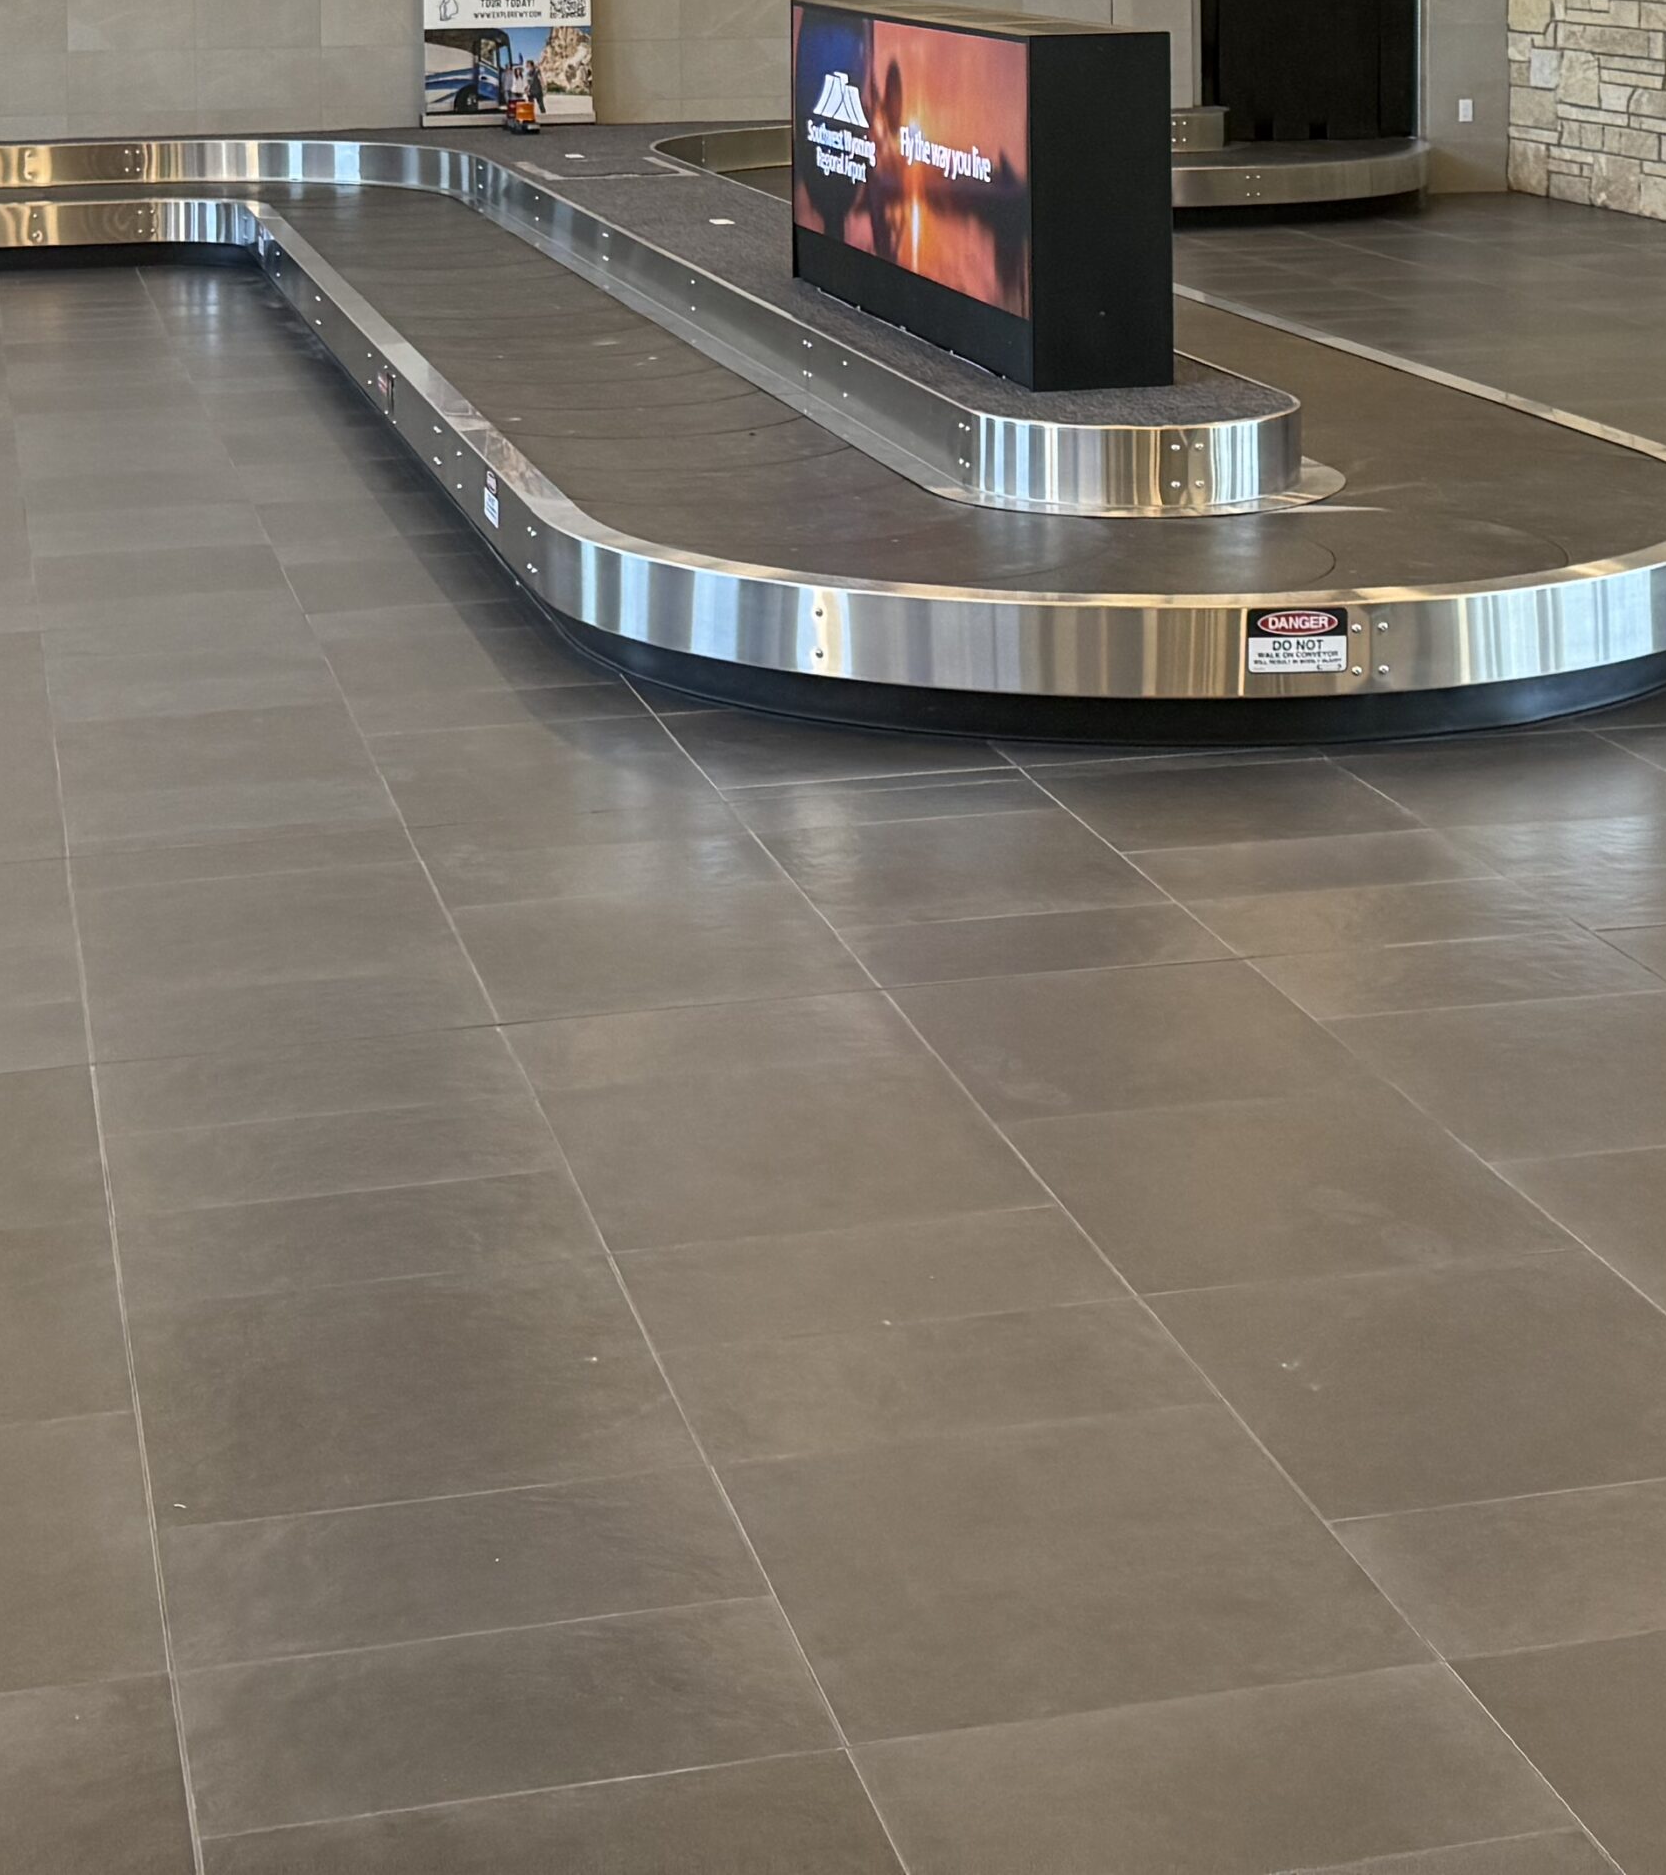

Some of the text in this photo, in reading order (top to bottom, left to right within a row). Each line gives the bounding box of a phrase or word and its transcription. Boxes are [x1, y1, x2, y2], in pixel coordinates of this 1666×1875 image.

[807, 119, 876, 167] Southwest Wyoming
[899, 126, 992, 183] Fly the way you live
[816, 146, 867, 184] Regional Airport
[1268, 616, 1329, 629] DANGER
[1272, 639, 1324, 651] DO NOT
